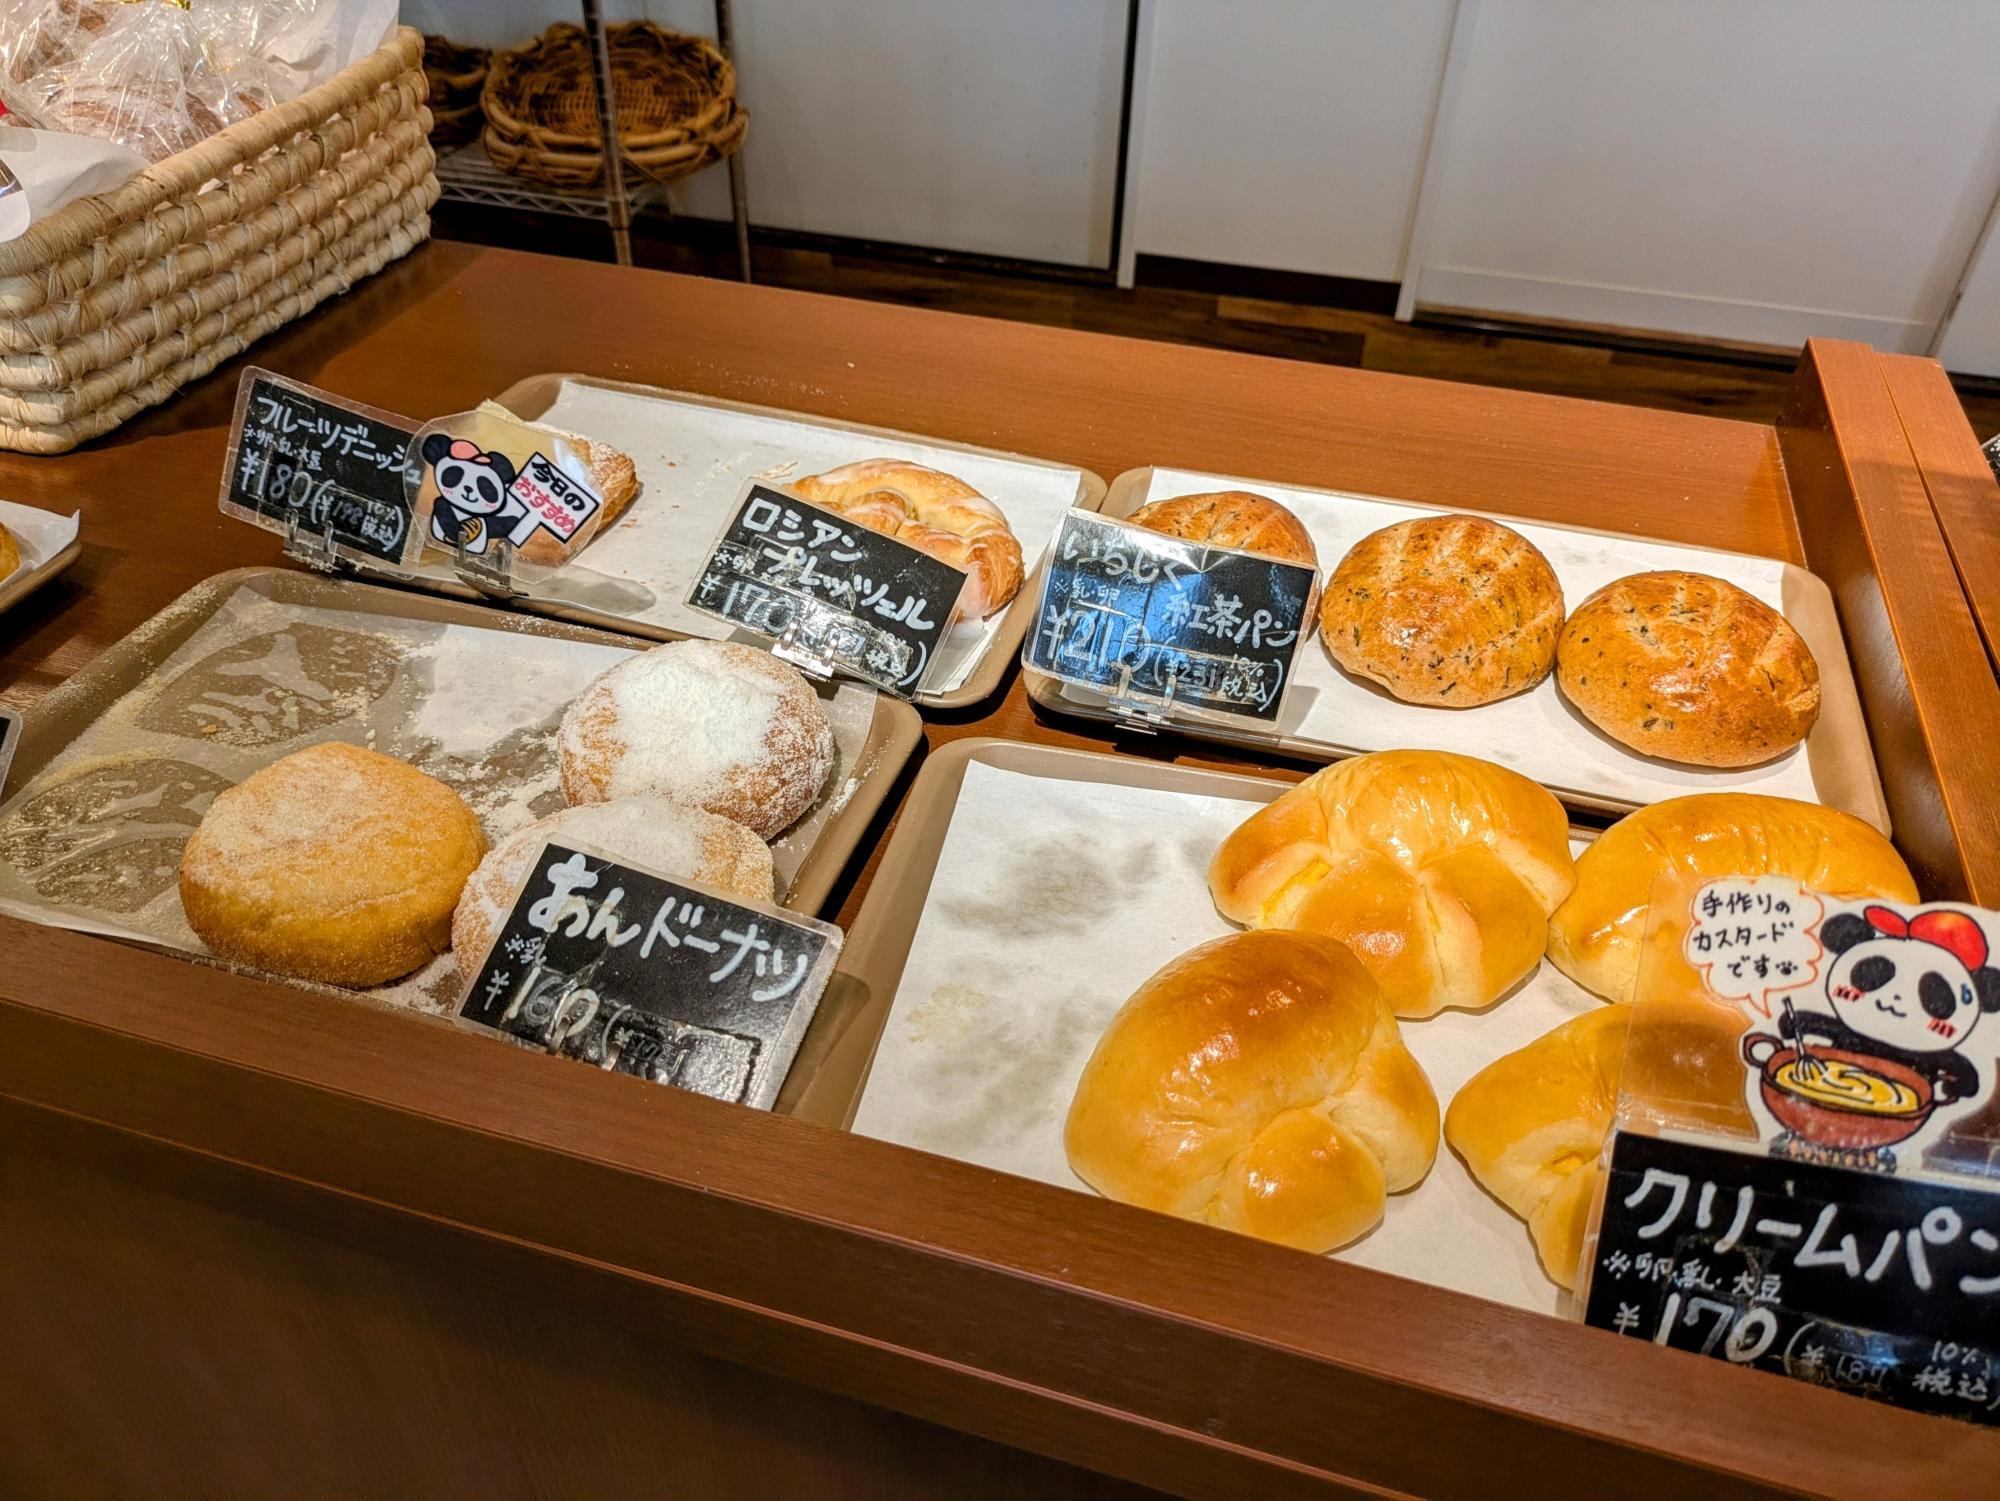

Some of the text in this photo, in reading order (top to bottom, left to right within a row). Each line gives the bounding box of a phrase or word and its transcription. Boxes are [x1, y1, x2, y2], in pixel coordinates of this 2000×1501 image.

[514, 475, 577, 534] おすすめ
[531, 461, 586, 512] 今日の
[743, 497, 863, 562] ロシアン
[763, 545, 935, 631] プレッツェル
[1162, 590, 1297, 649] 紅茶パン
[529, 854, 808, 1001] あんドーナツ
[1702, 889, 1790, 917] 手作りの
[1693, 921, 1794, 951] カスタード
[1728, 955, 1770, 978] です
[1613, 1292, 1778, 1362] ¥170
[1932, 1340, 1979, 1365] 10%
